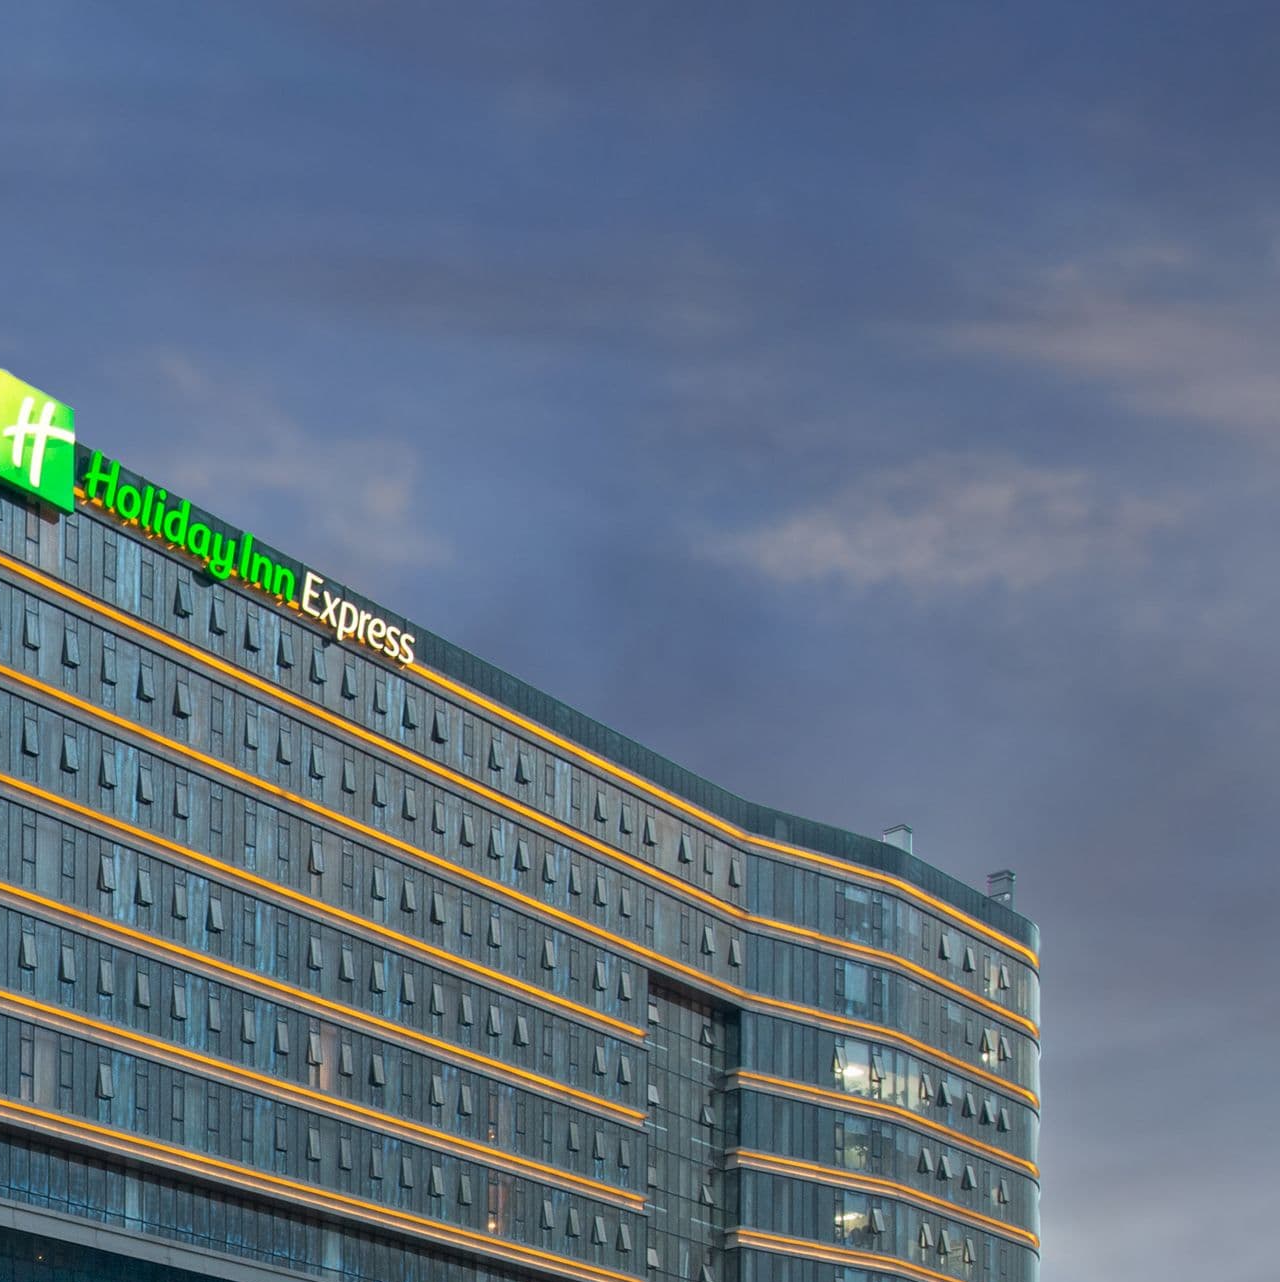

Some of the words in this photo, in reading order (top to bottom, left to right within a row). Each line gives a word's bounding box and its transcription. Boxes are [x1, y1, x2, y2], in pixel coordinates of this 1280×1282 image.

[85, 450, 237, 581] Holiday
[240, 533, 296, 601] Inn
[300, 571, 416, 665] Express
